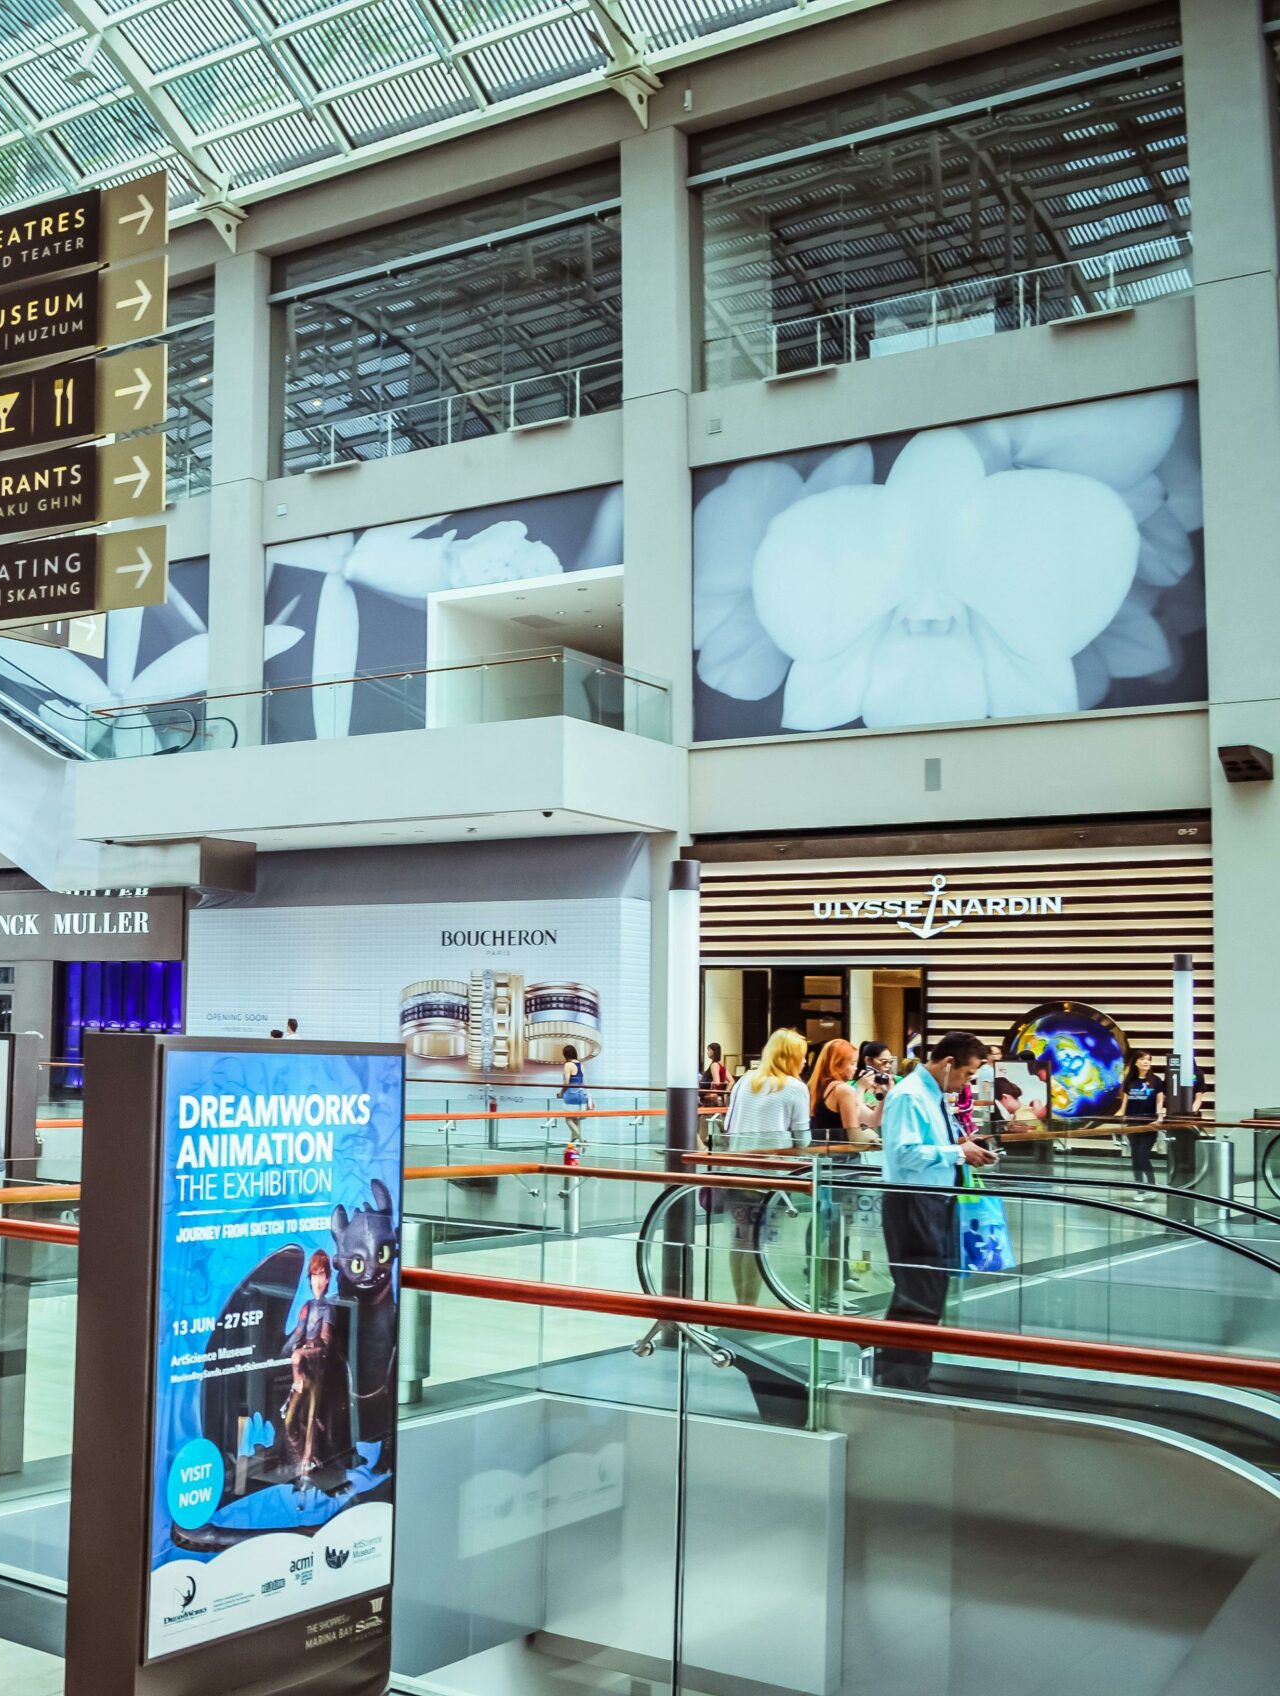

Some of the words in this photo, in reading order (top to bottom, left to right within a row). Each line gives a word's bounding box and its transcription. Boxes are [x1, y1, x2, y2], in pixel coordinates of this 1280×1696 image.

[20, 236, 86, 263] TEATER
[14, 319, 84, 345] MUZIUM
[37, 493, 83, 513] GHIN
[6, 581, 82, 604] SKATING
[813, 898, 924, 920] ULYSSE
[941, 896, 1063, 916] NARDIN
[53, 910, 151, 935] MULLER
[440, 929, 558, 947] BOUCHERON
[206, 1013, 242, 1021] OPENING
[244, 1013, 269, 1022] SOON
[178, 1093, 371, 1130] DREAMWORKS
[176, 1131, 334, 1169] ANIMATION
[176, 1173, 218, 1202] THE
[223, 1168, 333, 1199] EXHIBITION
[175, 1225, 221, 1243] JOURNEY
[222, 1223, 249, 1239] FROM
[250, 1219, 285, 1236] SKETCH
[286, 1218, 298, 1233] TO
[298, 1215, 332, 1233] SCREEN
[171, 1320, 188, 1336] 13
[190, 1317, 216, 1335] JUN
[224, 1312, 240, 1330] 27
[241, 1310, 264, 1328] SEP
[170, 1351, 218, 1367] ArtScience
[180, 1462, 213, 1484] VISIT
[178, 1487, 213, 1509] NOW
[289, 1551, 314, 1573] acmi
[352, 1546, 376, 1559] Museum
[305, 1623, 319, 1634] THE
[319, 1614, 346, 1631] SHOPPES
[304, 1631, 337, 1650] MARINA
[338, 1625, 354, 1639] BAY
